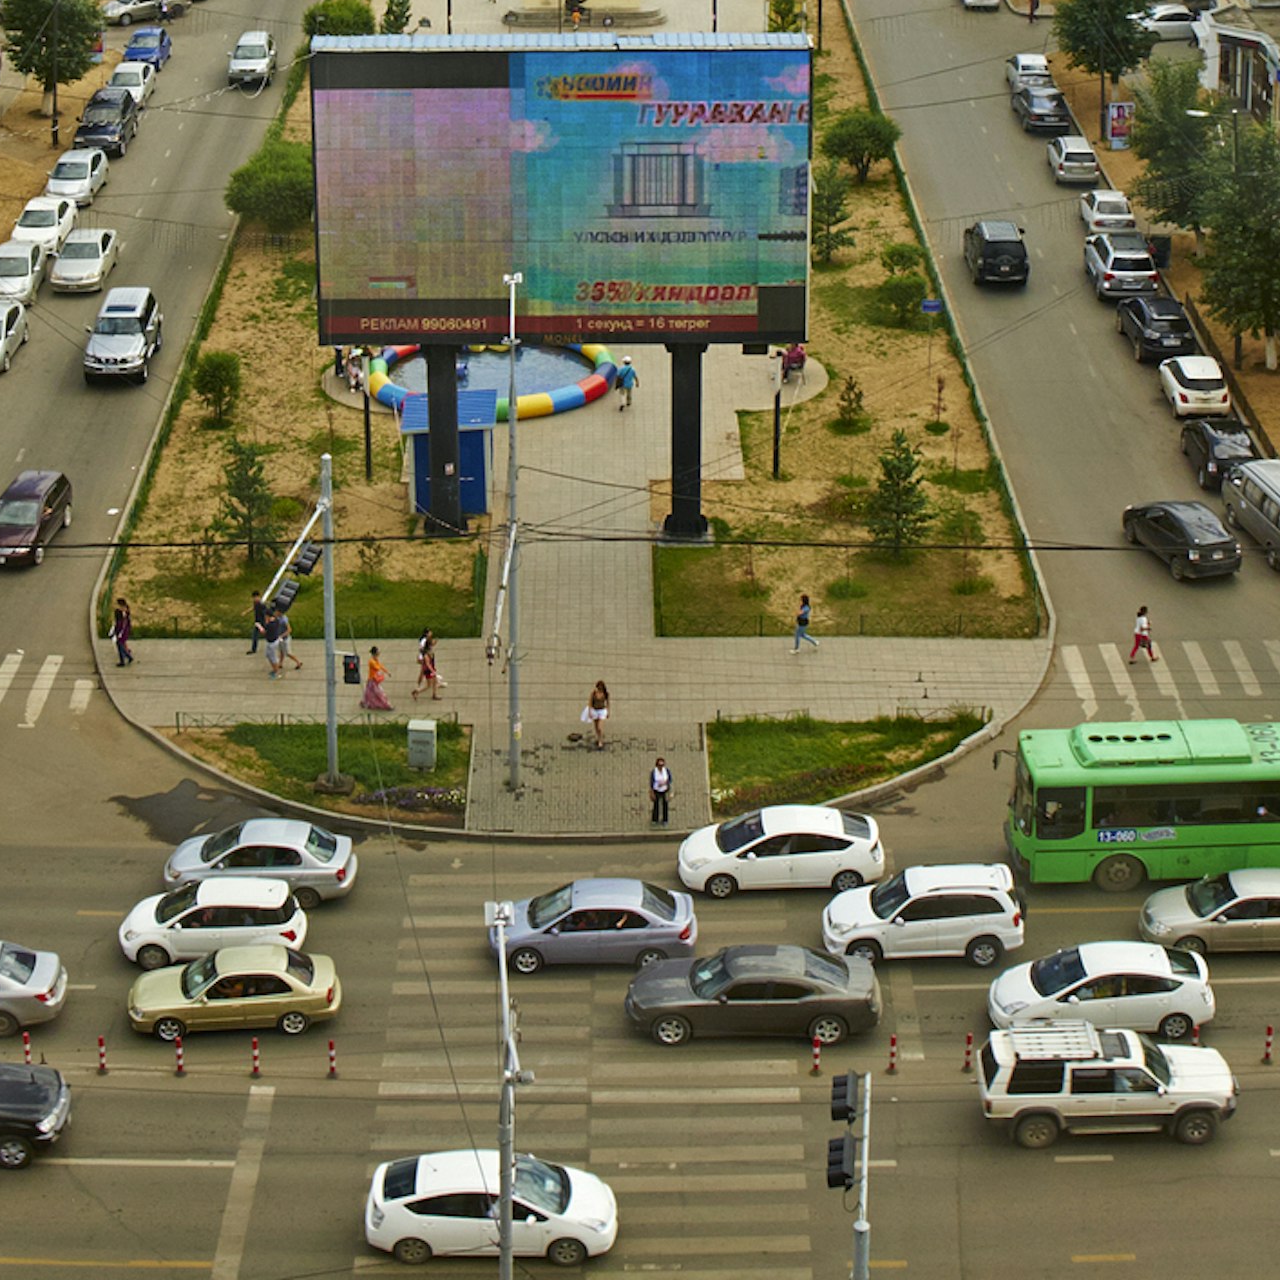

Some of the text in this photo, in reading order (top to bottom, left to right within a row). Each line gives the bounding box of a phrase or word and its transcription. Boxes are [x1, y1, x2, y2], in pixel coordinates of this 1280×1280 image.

[361, 318, 487, 330] РЕКЛАМ 99060491
[576, 318, 583, 328] 1
[587, 320, 634, 332] секунд
[649, 318, 665, 328] 16
[668, 320, 712, 331] төгрөг
[1099, 830, 1136, 841] 13-060
